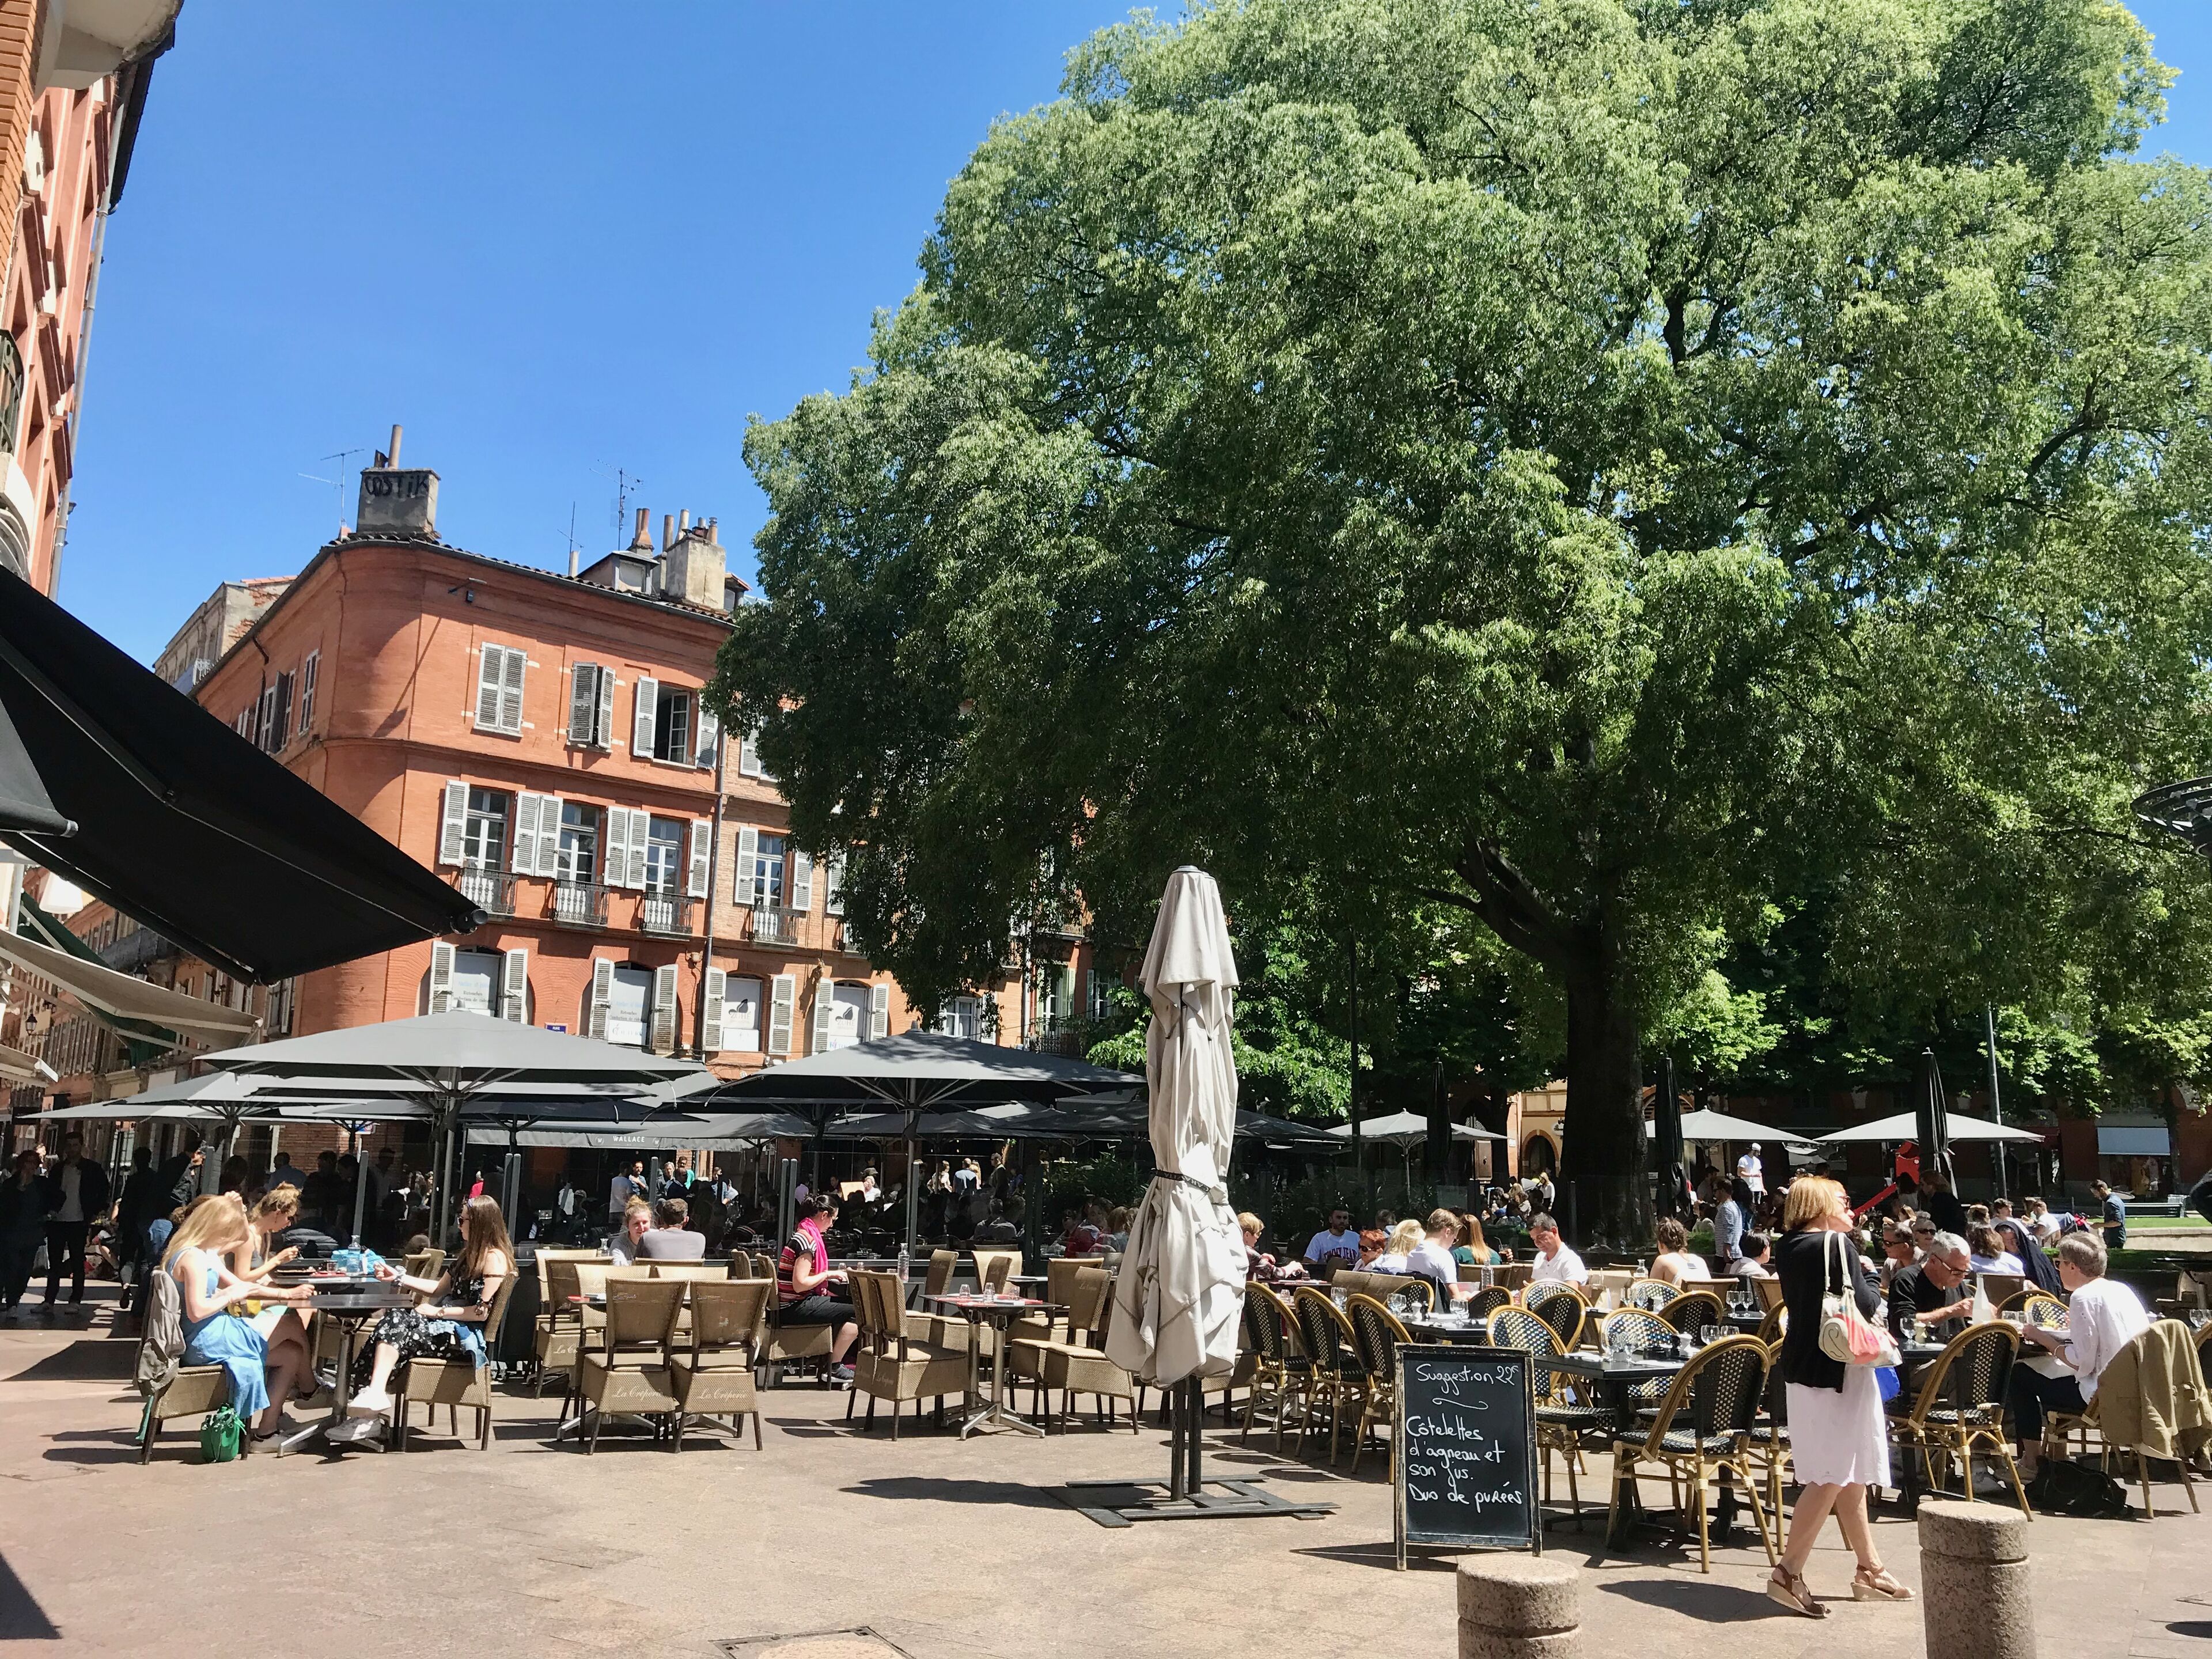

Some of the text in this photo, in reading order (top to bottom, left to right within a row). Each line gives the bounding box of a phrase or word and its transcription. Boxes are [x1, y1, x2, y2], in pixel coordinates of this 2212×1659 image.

[553, 1345, 566, 1354] La
[612, 1387, 627, 1397] La
[1416, 1363, 1494, 1395] Suggestion
[1406, 1413, 1483, 1442] Côtelettes
[1410, 1438, 1505, 1469] d'agneau et
[1409, 1461, 1474, 1488] son jus.
[1408, 1482, 1438, 1502] Duo
[1447, 1484, 1469, 1505] de
